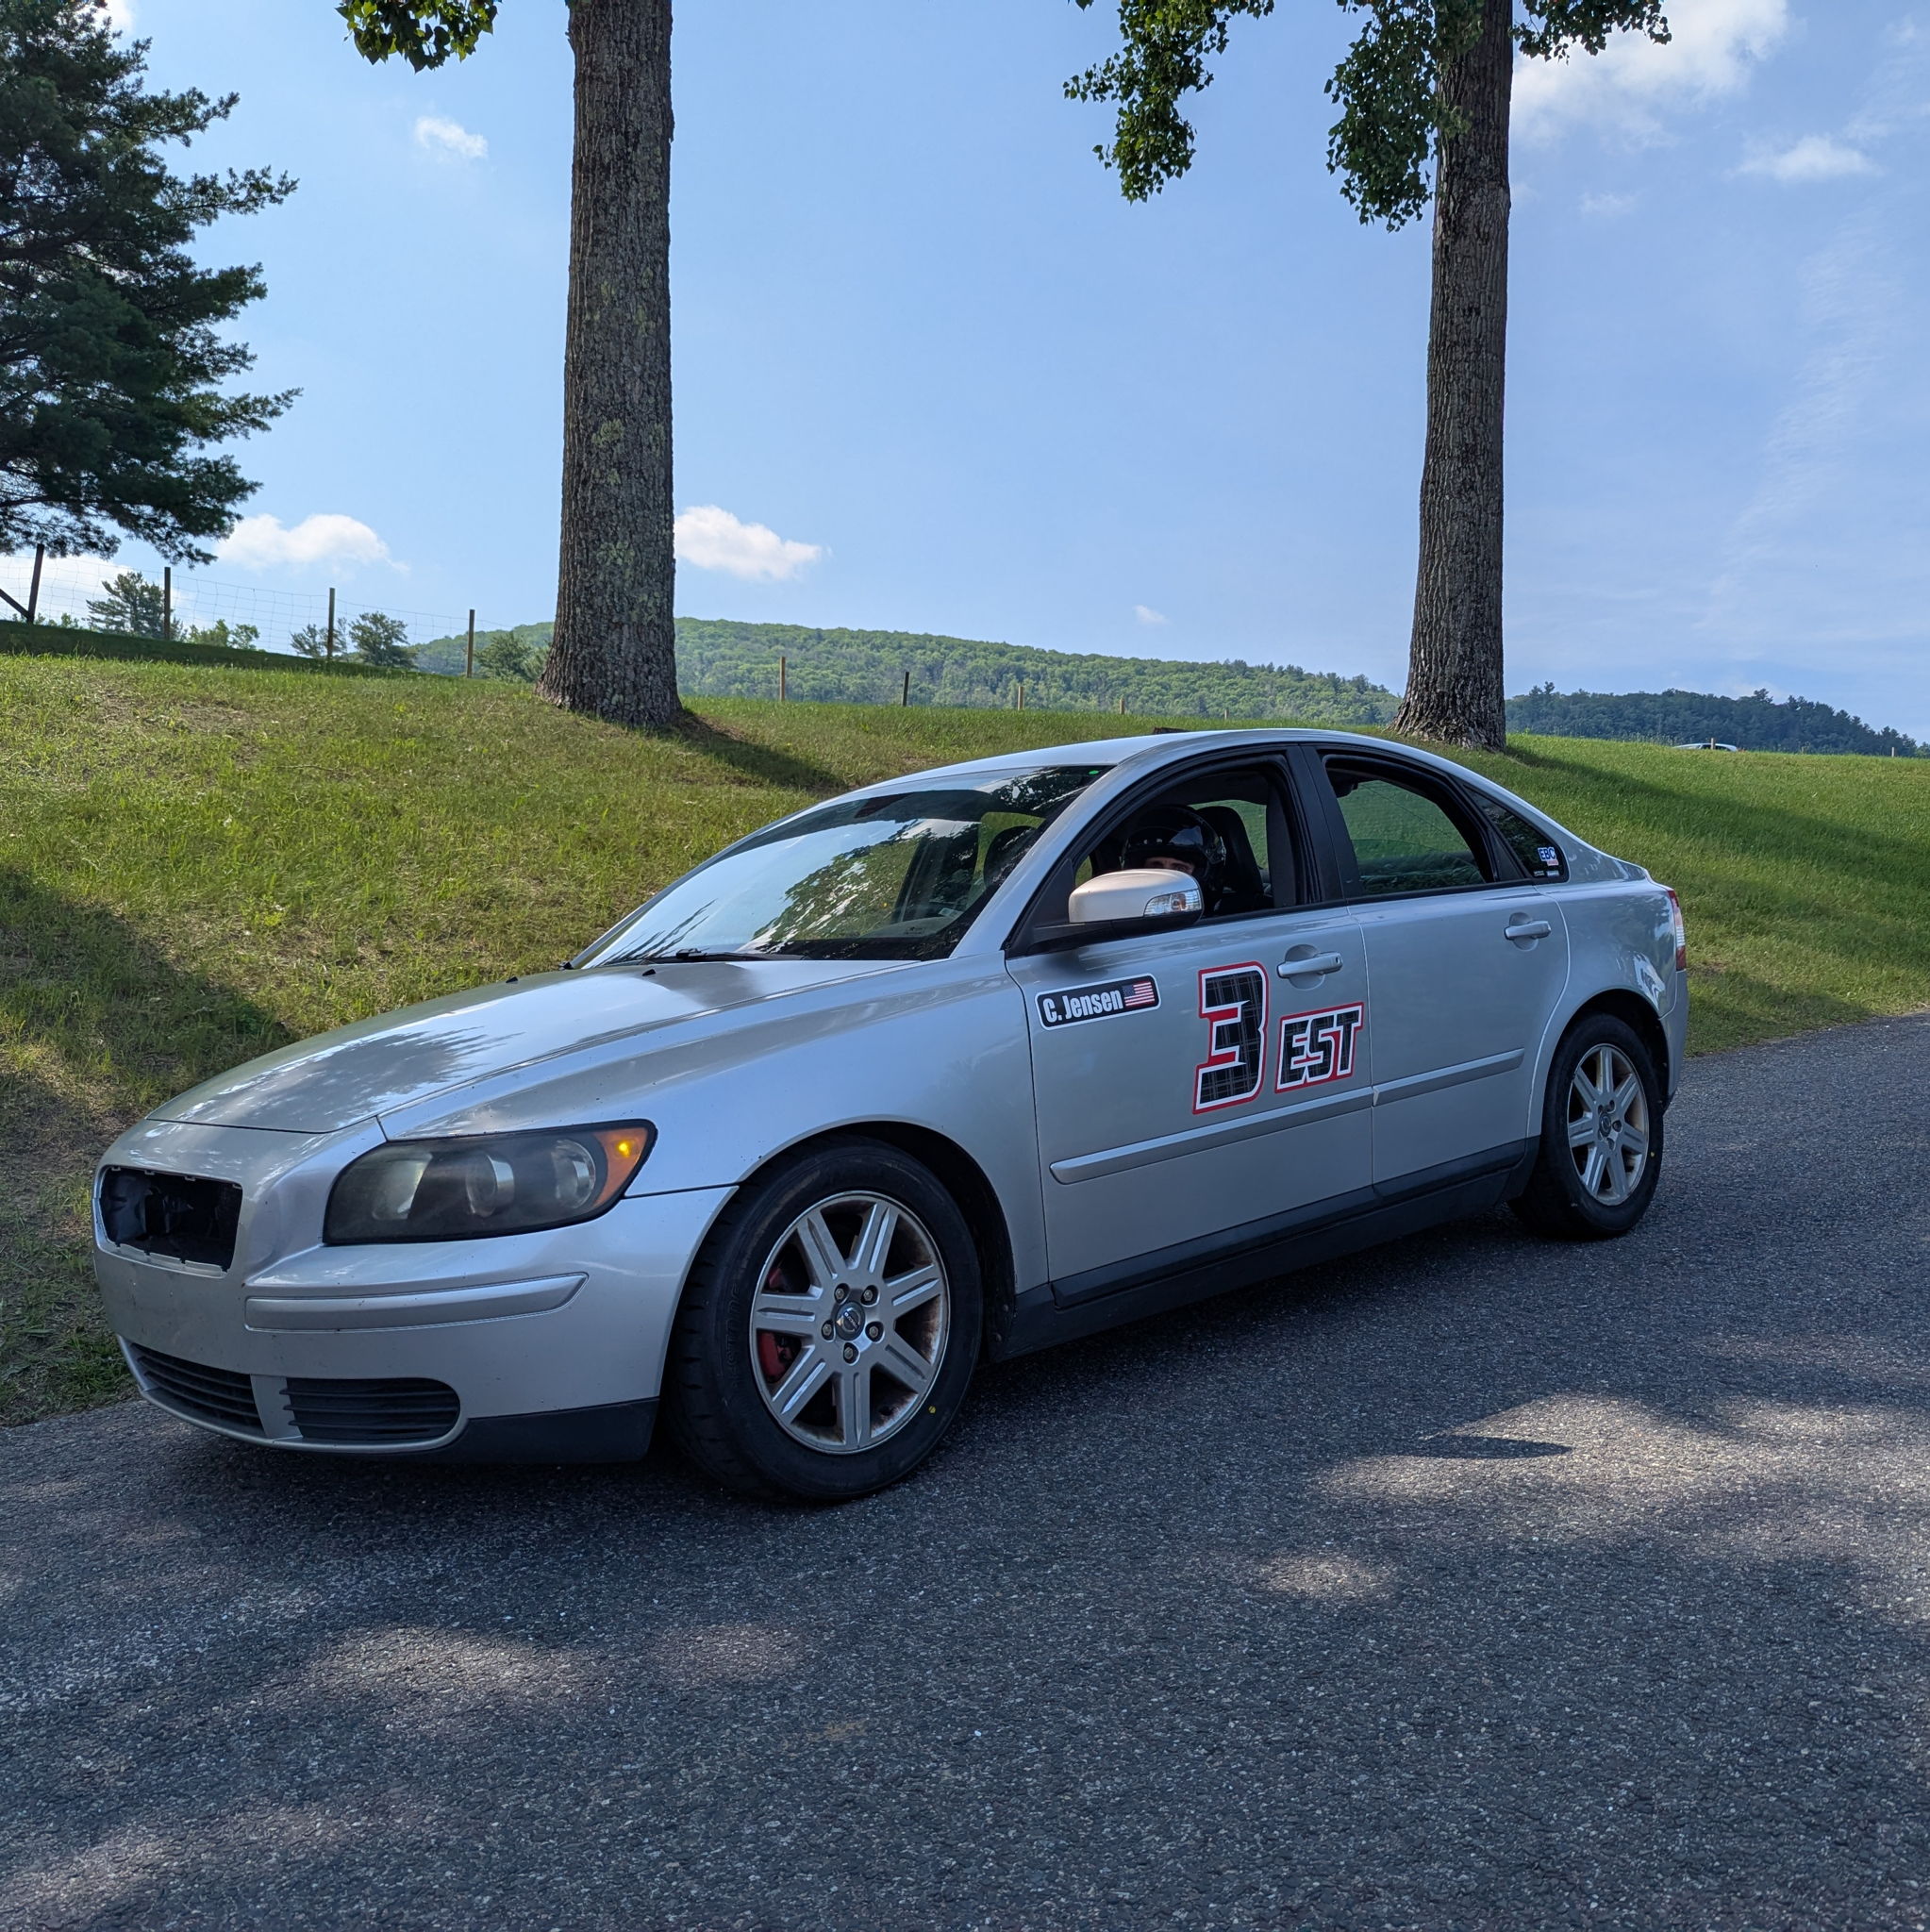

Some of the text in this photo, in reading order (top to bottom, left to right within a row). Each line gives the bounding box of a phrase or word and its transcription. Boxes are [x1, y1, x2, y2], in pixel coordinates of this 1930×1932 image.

[1539, 848, 1556, 860] EBC
[1042, 990, 1123, 1023] C. Jensen
[1195, 964, 1362, 1110] 3 EST
